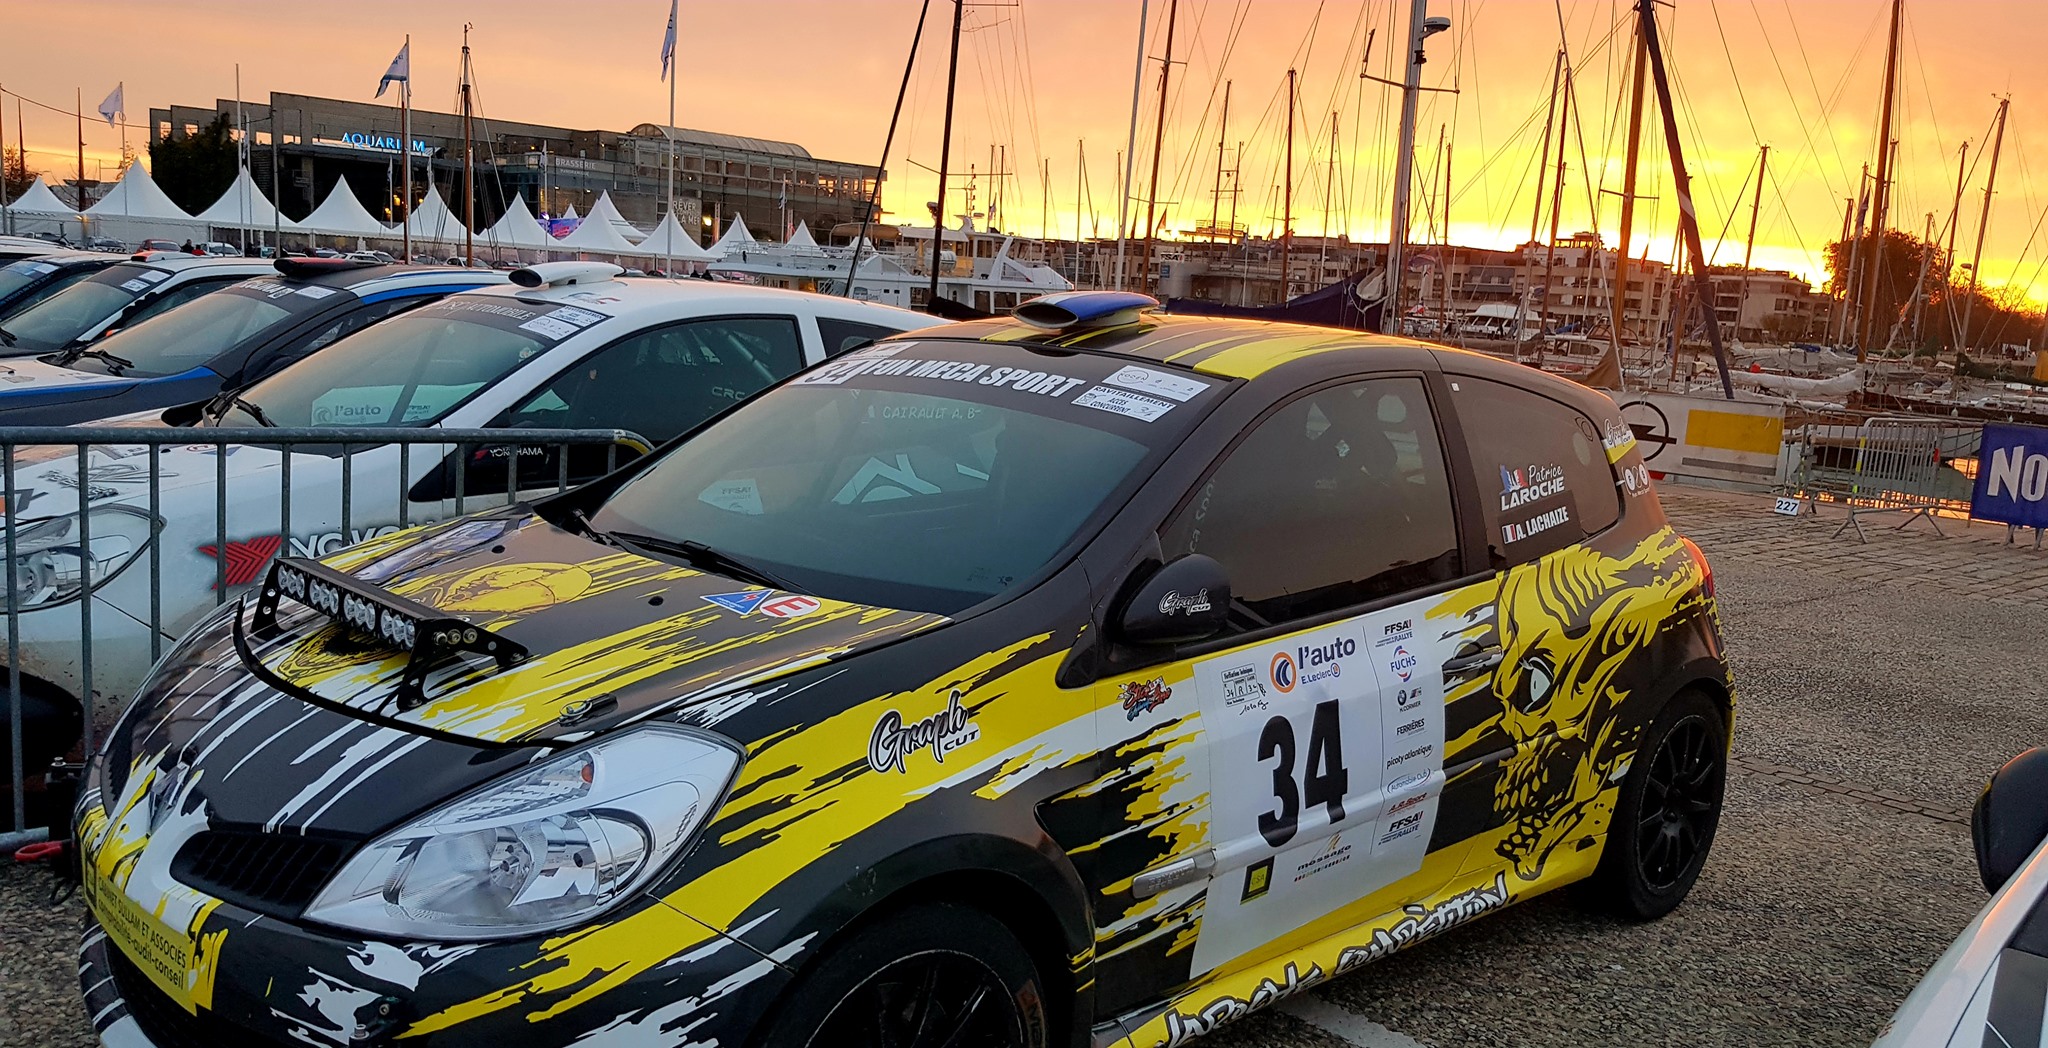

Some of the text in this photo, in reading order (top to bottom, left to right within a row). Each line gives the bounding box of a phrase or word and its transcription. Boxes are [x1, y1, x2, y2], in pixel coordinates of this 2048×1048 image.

[341, 132, 426, 153] AQUARIM
[555, 158, 596, 170] BRASSERIE
[804, 359, 870, 383] 34
[860, 359, 922, 377] FUN
[978, 366, 1087, 398] SPORT
[1093, 386, 1174, 409] RAVITAILLEMENT
[335, 404, 381, 416] l'auto
[490, 447, 543, 458] YOKHAMA
[1528, 463, 1563, 486] Patrice
[1501, 476, 1565, 511] LAROCHE
[1776, 499, 1798, 512] 227
[1516, 506, 1569, 540] A. LACHAIZE
[763, 596, 818, 617] E
[1159, 588, 1208, 616] Graph
[1394, 631, 1413, 642] RALLYE
[1298, 637, 1356, 670] l'auto
[1390, 655, 1417, 672] FUCHS
[868, 689, 968, 774] Graph
[1396, 718, 1425, 735] FERRIÈRES
[943, 729, 979, 751] CUT
[1257, 698, 1348, 848] 34
[1390, 774, 1416, 791] Automobile
[141, 921, 150, 939] ET
